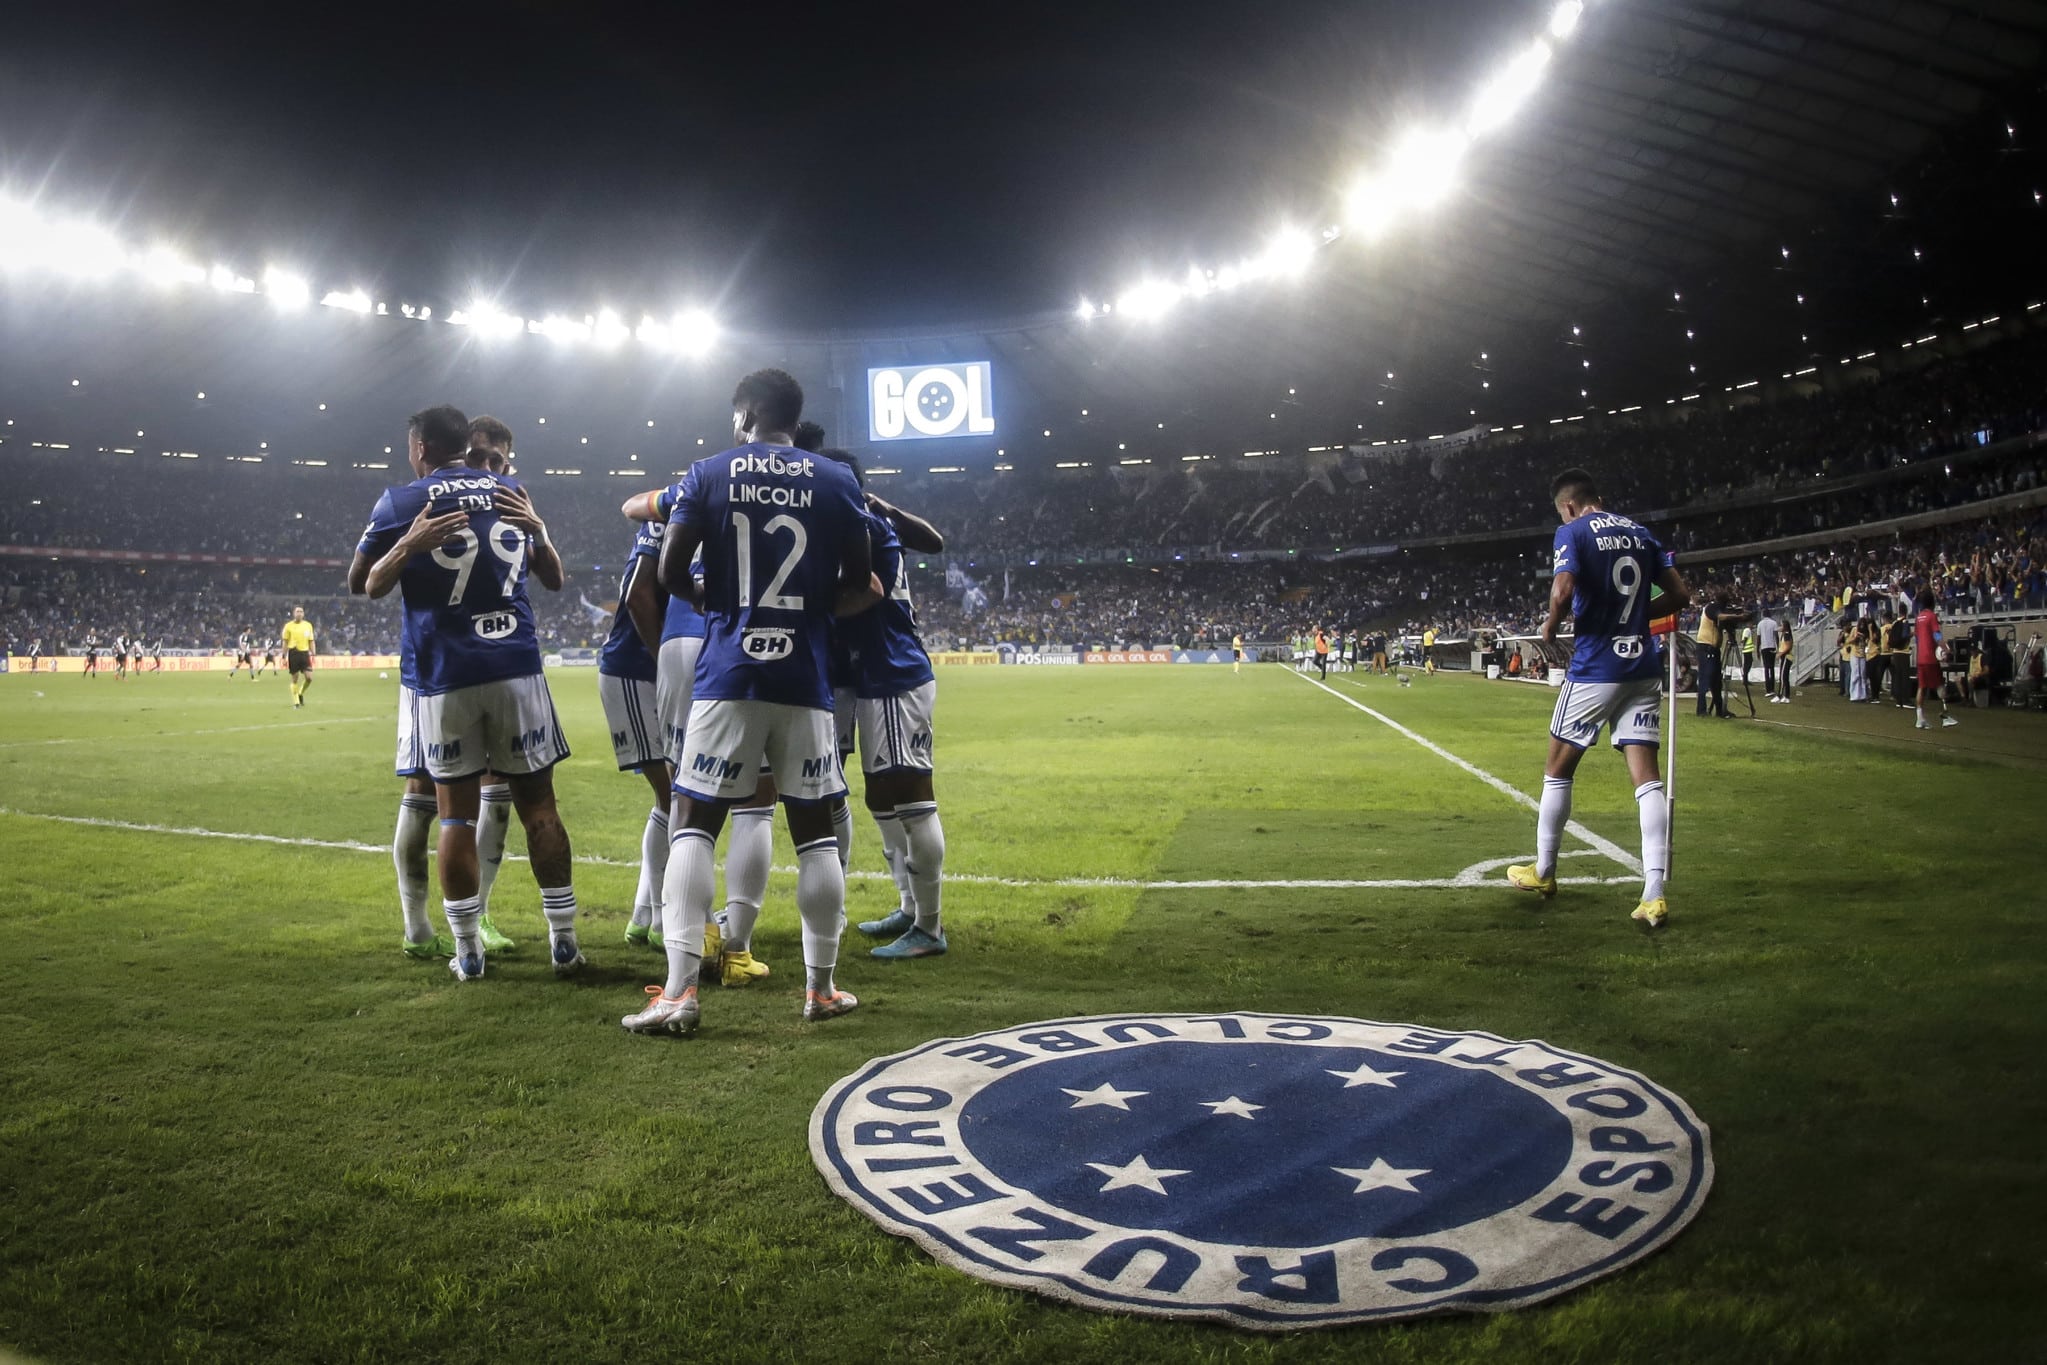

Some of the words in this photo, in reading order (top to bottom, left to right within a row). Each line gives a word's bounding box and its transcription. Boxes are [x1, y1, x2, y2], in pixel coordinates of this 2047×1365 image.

[874, 365, 995, 438] GOL
[729, 454, 815, 478] pixbet
[428, 475, 498, 501] pixbet
[728, 484, 813, 508] LINCOLN
[458, 494, 493, 512] EDU
[1595, 535, 1632, 551] BRUNO
[430, 520, 527, 606] 99
[732, 512, 807, 611] 12
[1612, 556, 1642, 624] 9
[482, 615, 510, 635] BH
[749, 636, 787, 653] BH
[1042, 655, 1079, 665] UNIUBE
[1087, 653, 1105, 663] GOL
[1108, 653, 1126, 663] GOL
[1129, 653, 1147, 663] GOL
[1149, 653, 1167, 663] GOL
[943, 1018, 1333, 1069] CLUBE
[1386, 1032, 1676, 1240] ESPORTE
[854, 1086, 1479, 1304] CRUZEIRO
